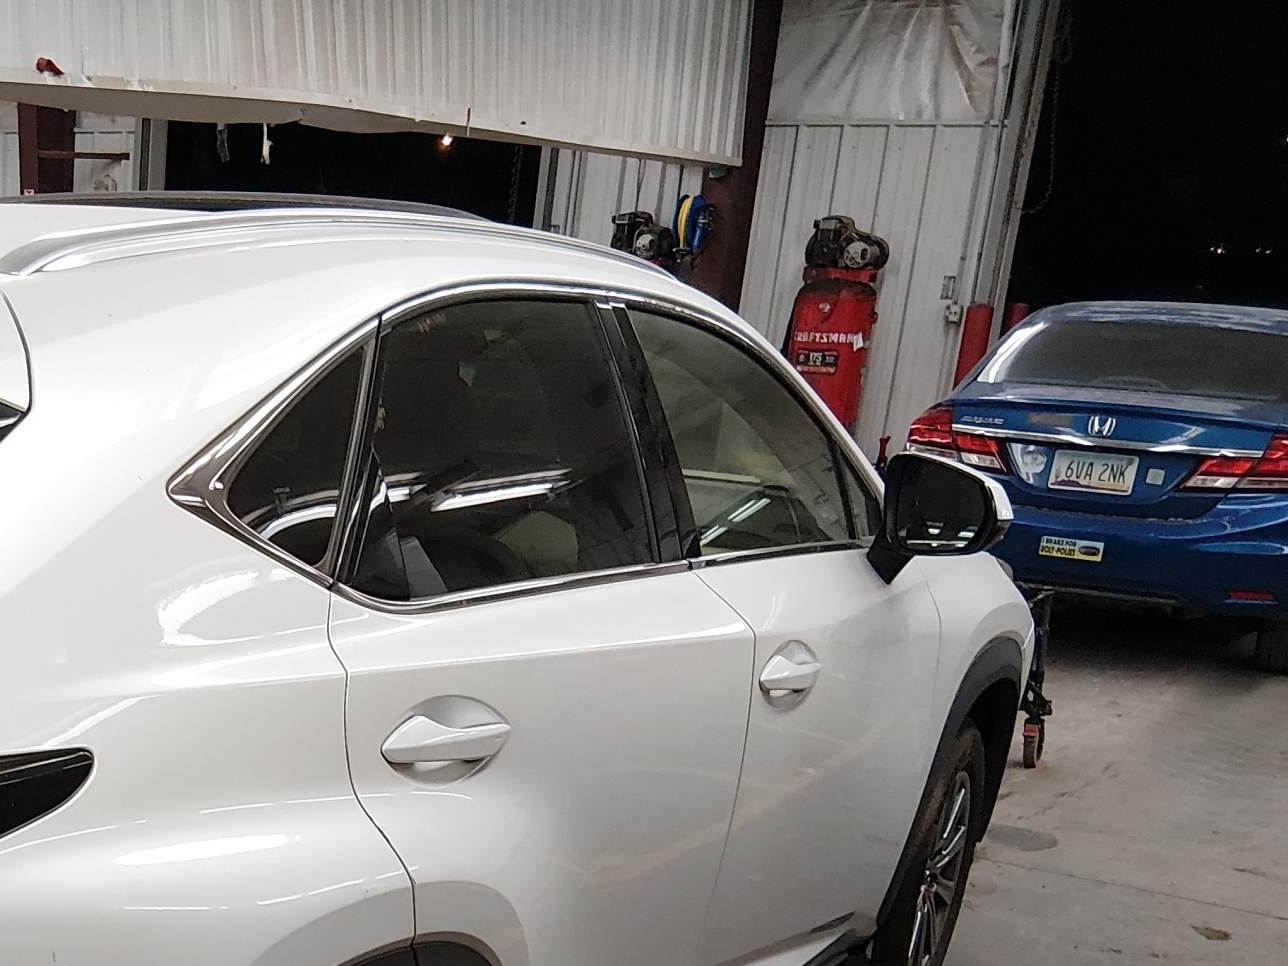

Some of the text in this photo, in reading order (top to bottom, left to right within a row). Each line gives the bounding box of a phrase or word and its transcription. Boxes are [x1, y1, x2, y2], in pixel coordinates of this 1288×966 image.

[795, 332, 854, 343] CRAFTSMAN
[1065, 460, 1129, 484] 6VA 2NK
